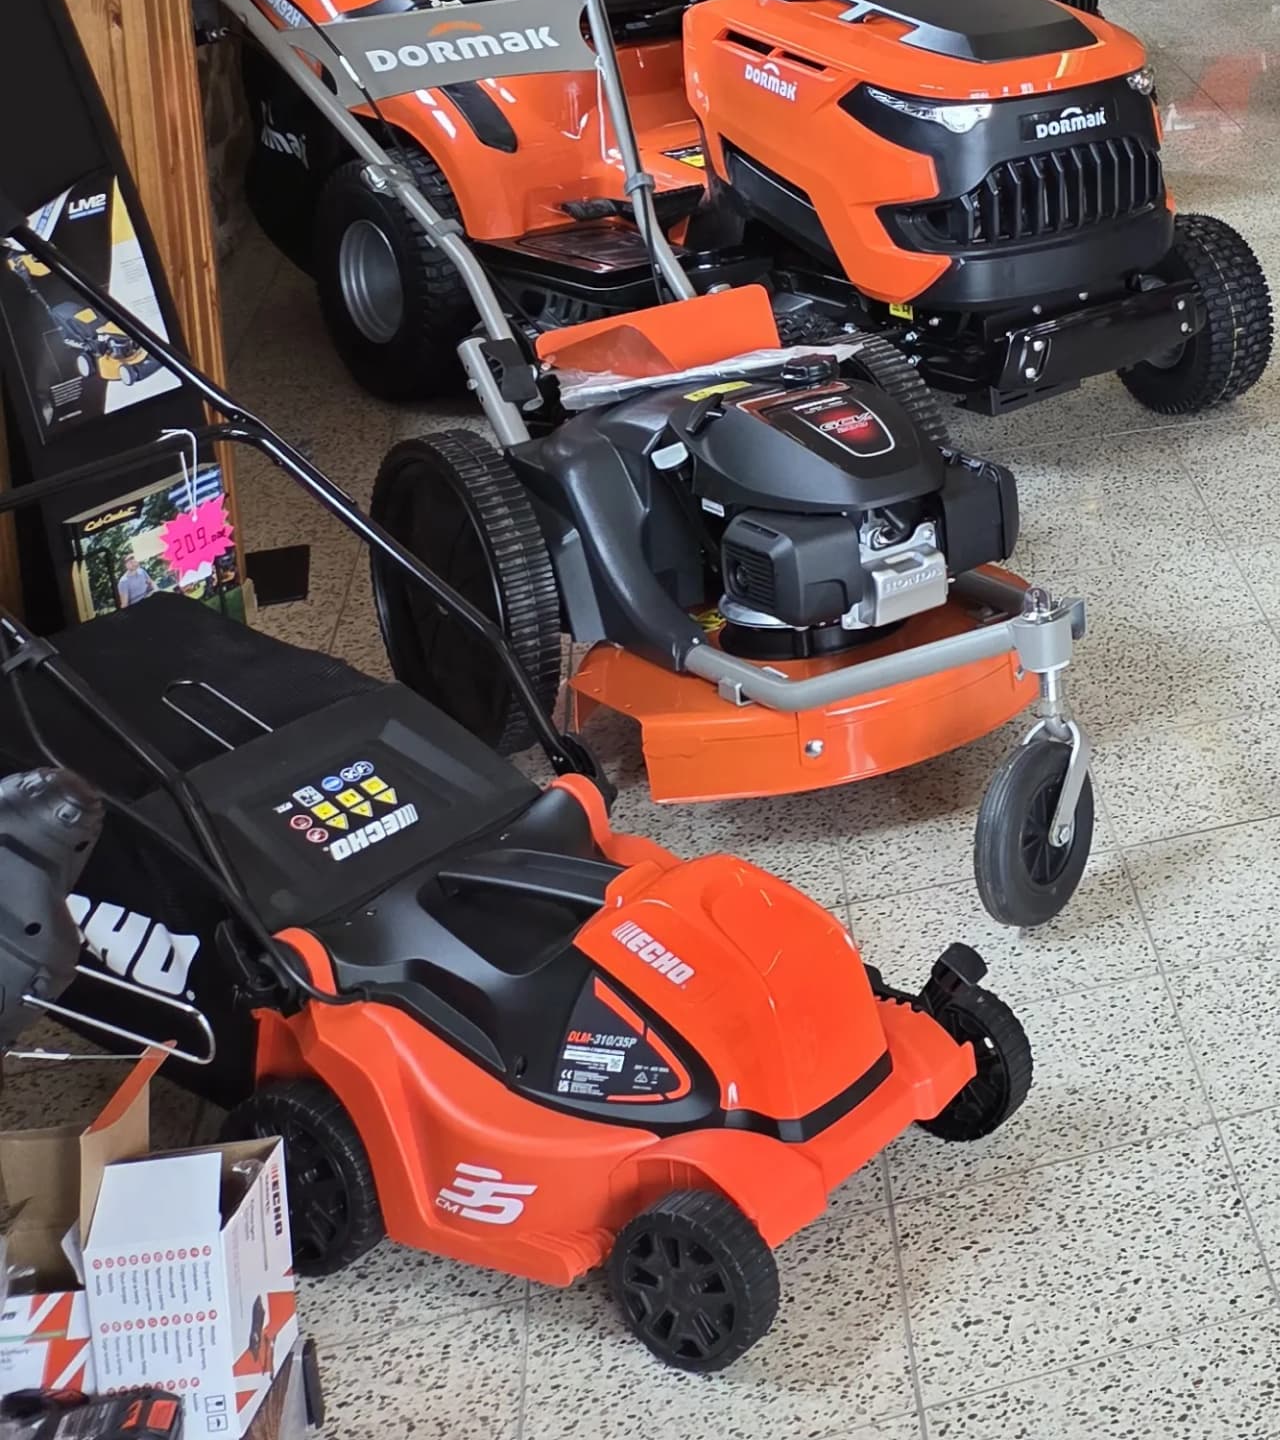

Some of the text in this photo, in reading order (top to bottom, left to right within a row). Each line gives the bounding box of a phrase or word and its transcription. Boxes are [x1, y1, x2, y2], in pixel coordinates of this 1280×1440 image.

[69, 193, 107, 215] LM2
[331, 813, 401, 862] ECHO
[626, 932, 696, 986] ECHO
[567, 1030, 638, 1049] DLM-310/35P
[271, 1181, 284, 1237] ECHO
